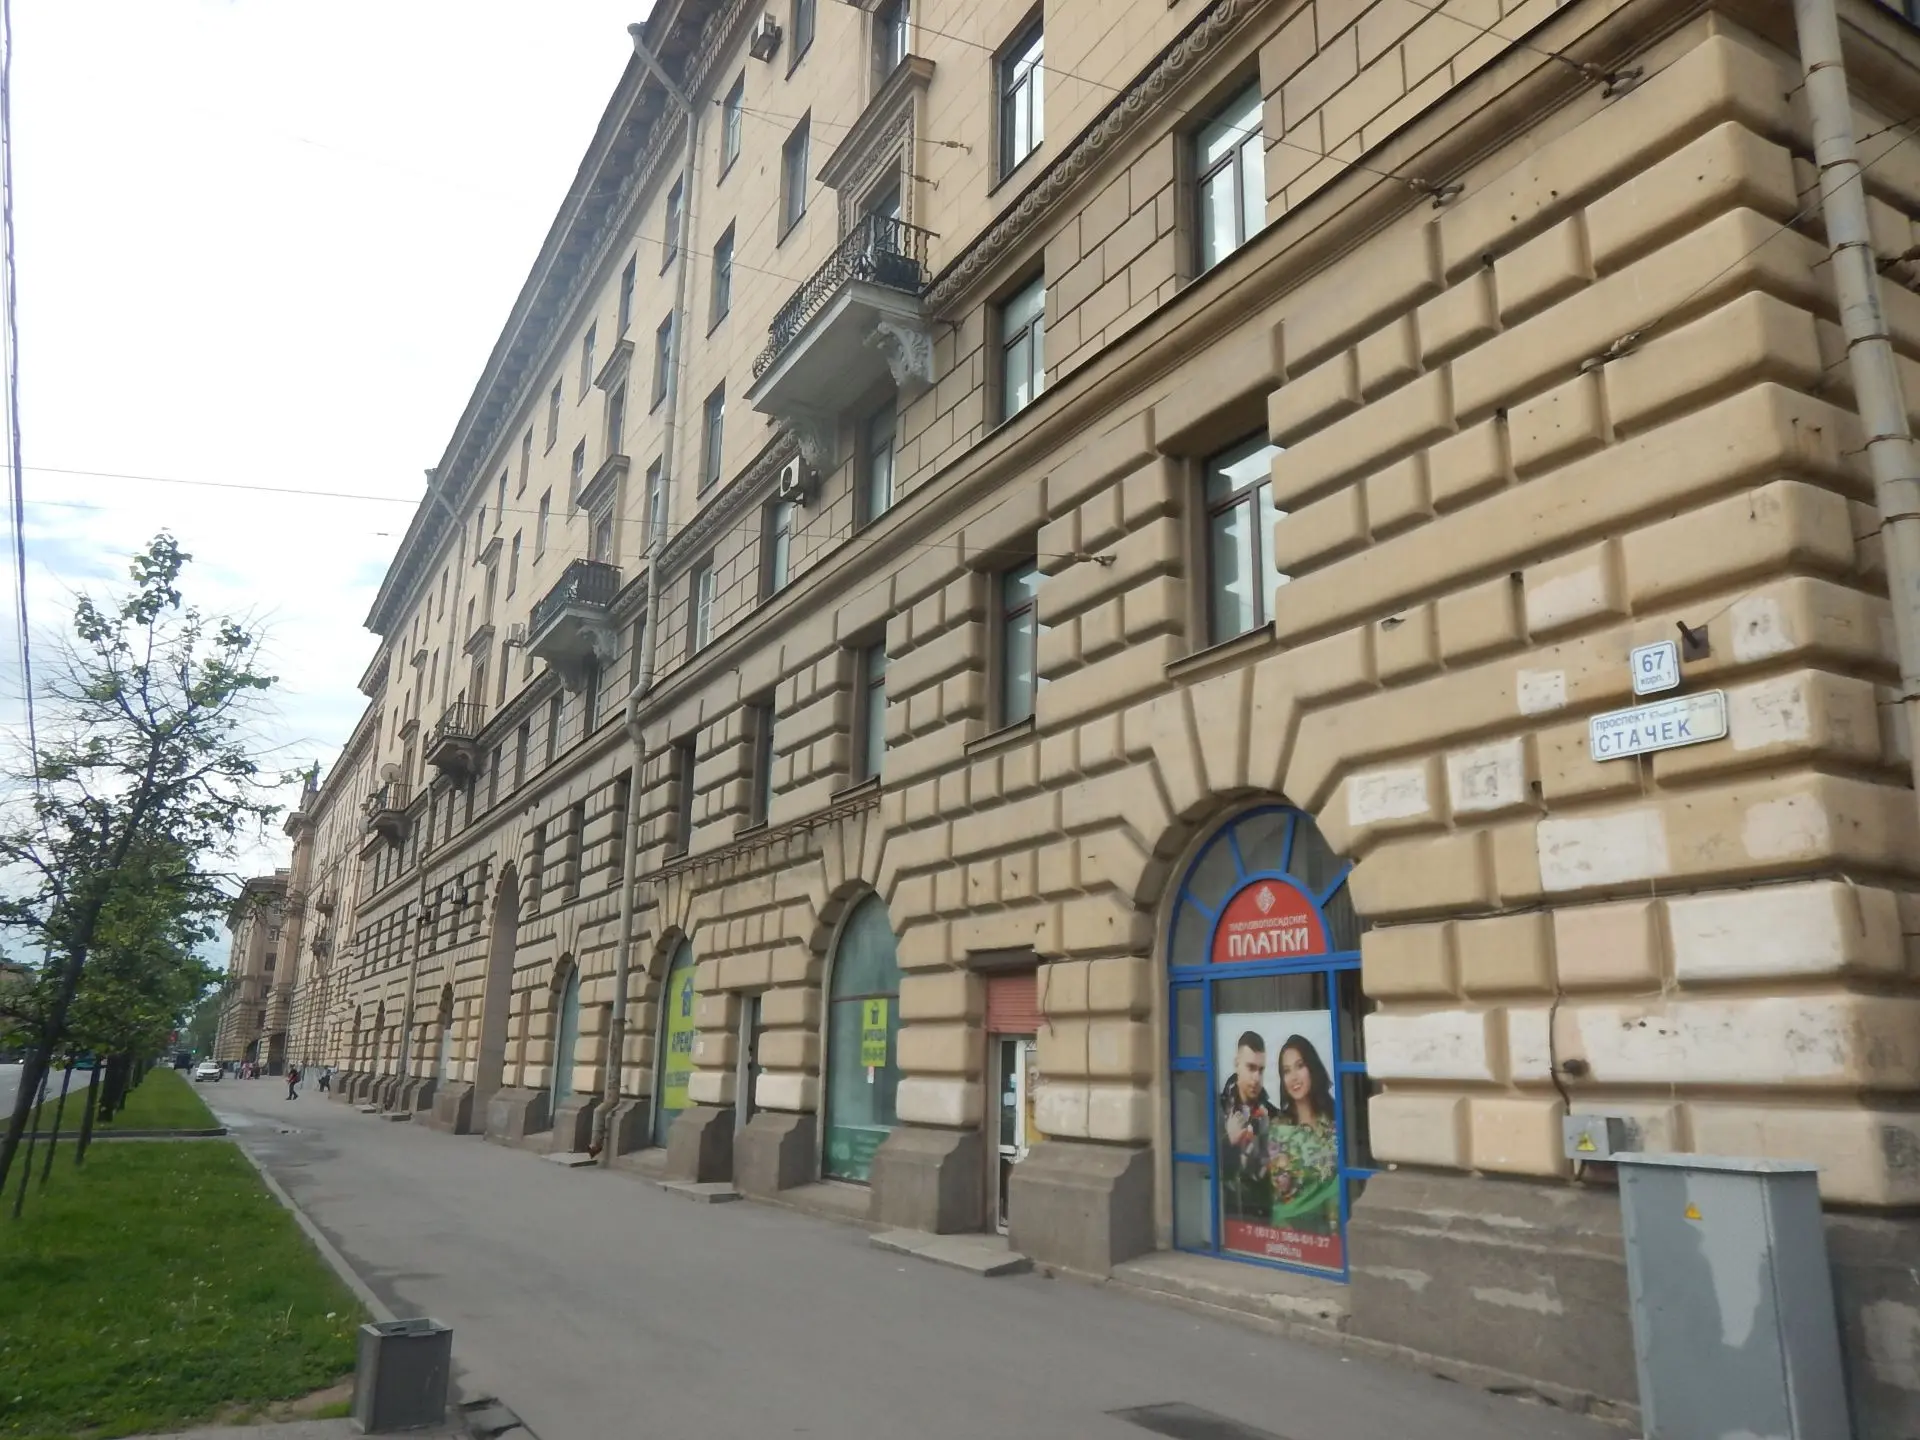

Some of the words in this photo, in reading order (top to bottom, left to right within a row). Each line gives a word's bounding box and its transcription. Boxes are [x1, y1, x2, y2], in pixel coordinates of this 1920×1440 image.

[1642, 651, 1665, 673] 67
[1596, 712, 1646, 731] проспект
[1598, 718, 1691, 753] СТАЧЕК
[1229, 927, 1309, 958] ПЛАТКИ
